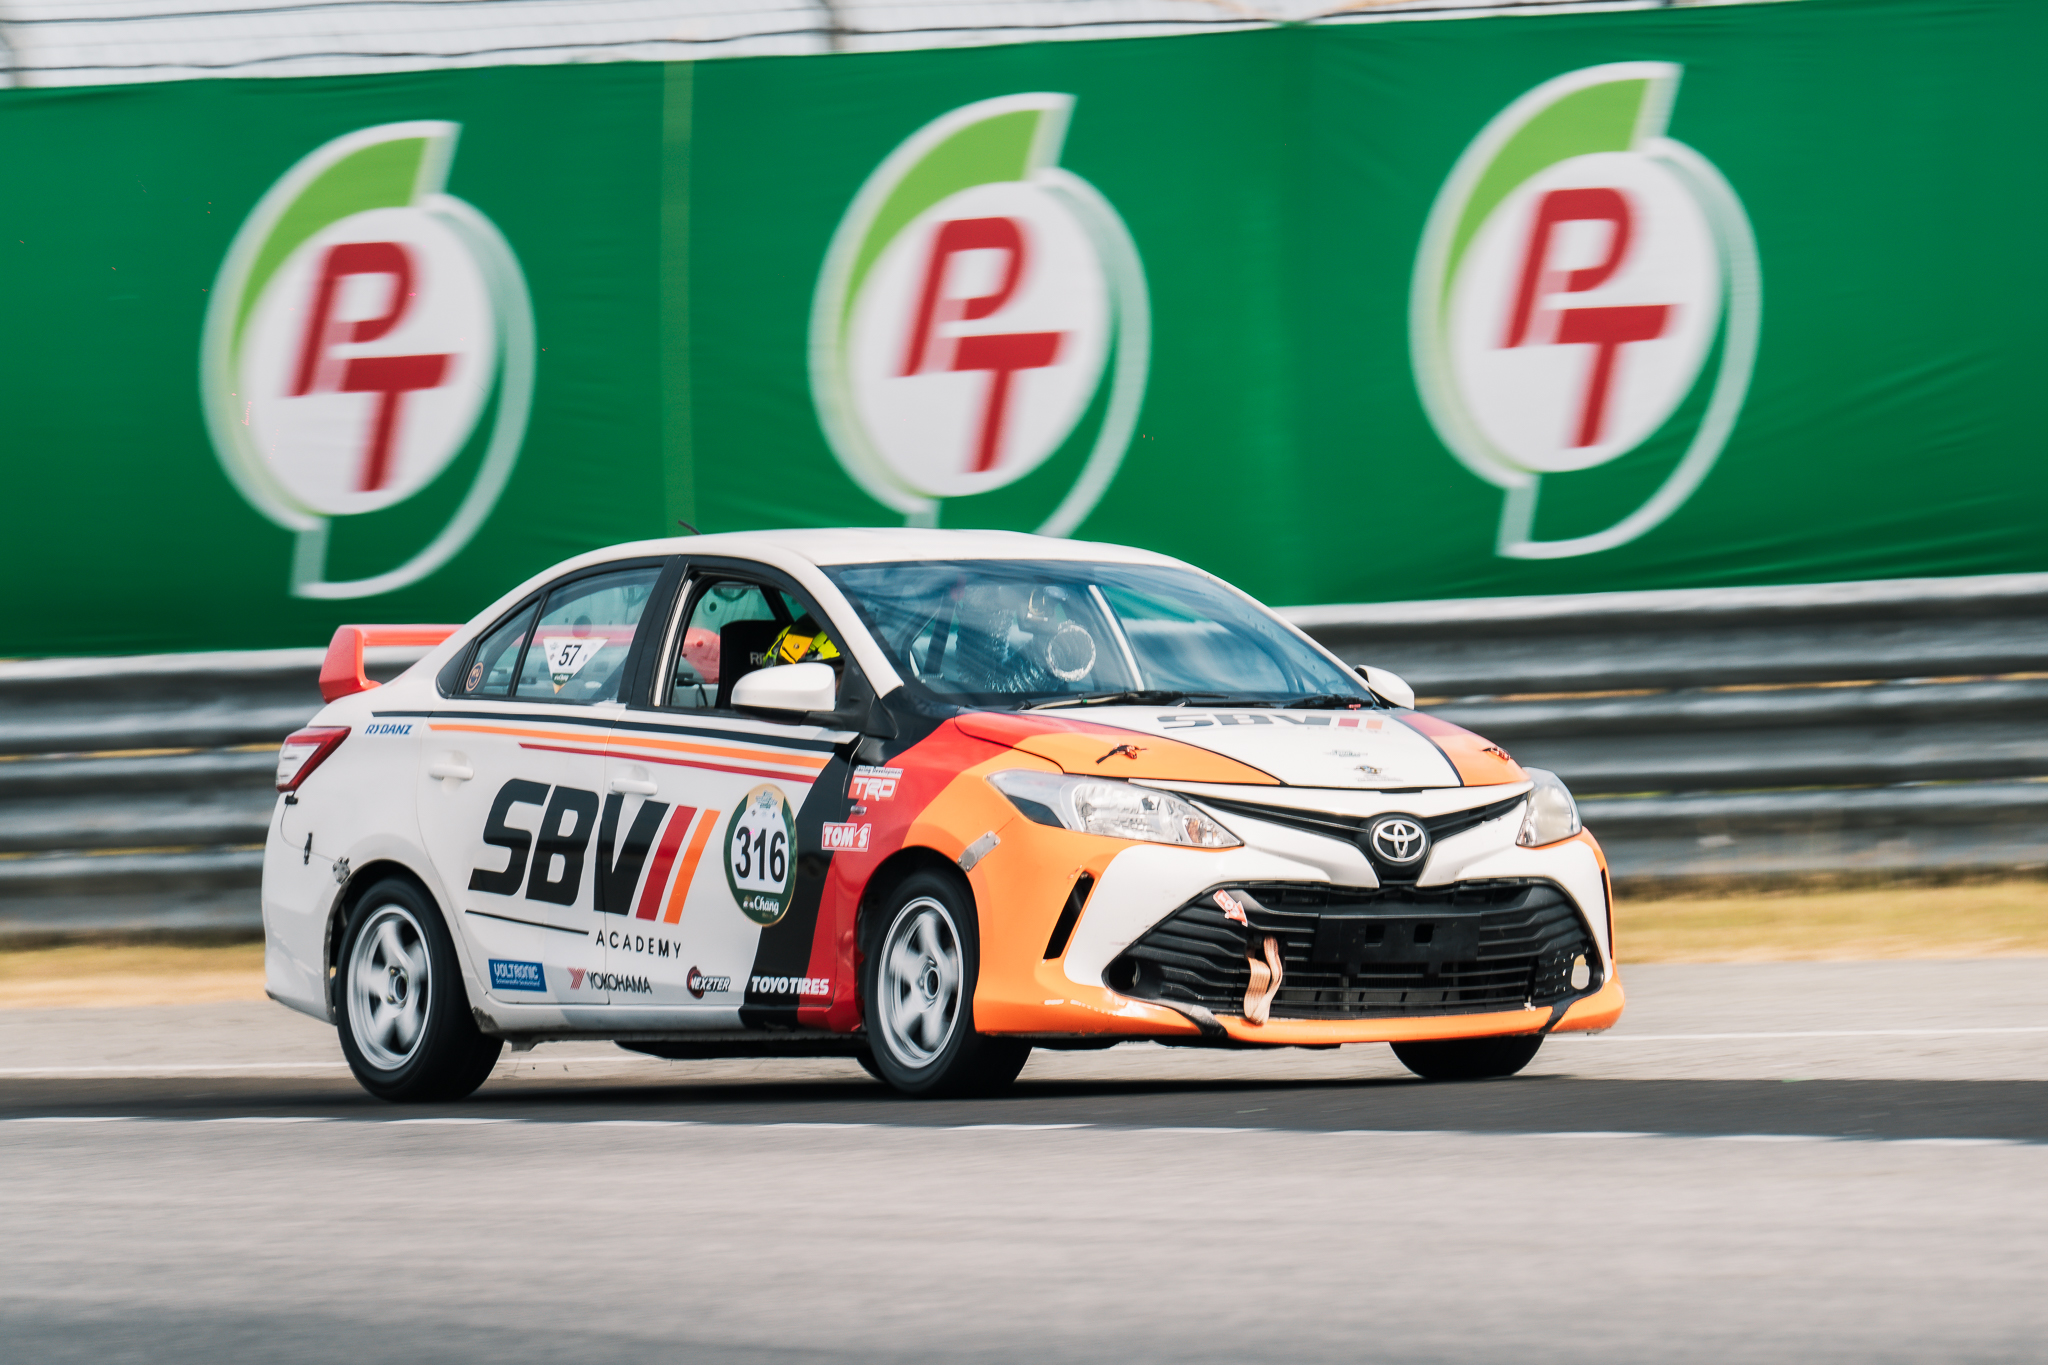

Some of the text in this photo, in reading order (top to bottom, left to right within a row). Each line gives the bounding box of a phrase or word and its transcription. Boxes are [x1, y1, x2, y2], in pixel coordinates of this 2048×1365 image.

[558, 644, 582, 667] 57
[853, 776, 896, 802] TRD
[467, 777, 671, 917] SBV
[735, 826, 786, 883] 316
[754, 895, 780, 916] Chang
[595, 930, 682, 959] ACADEMY
[493, 962, 539, 980] VOLTRONIC
[587, 971, 653, 995] YOKOHAMA
[690, 975, 731, 993] NEXZTER
